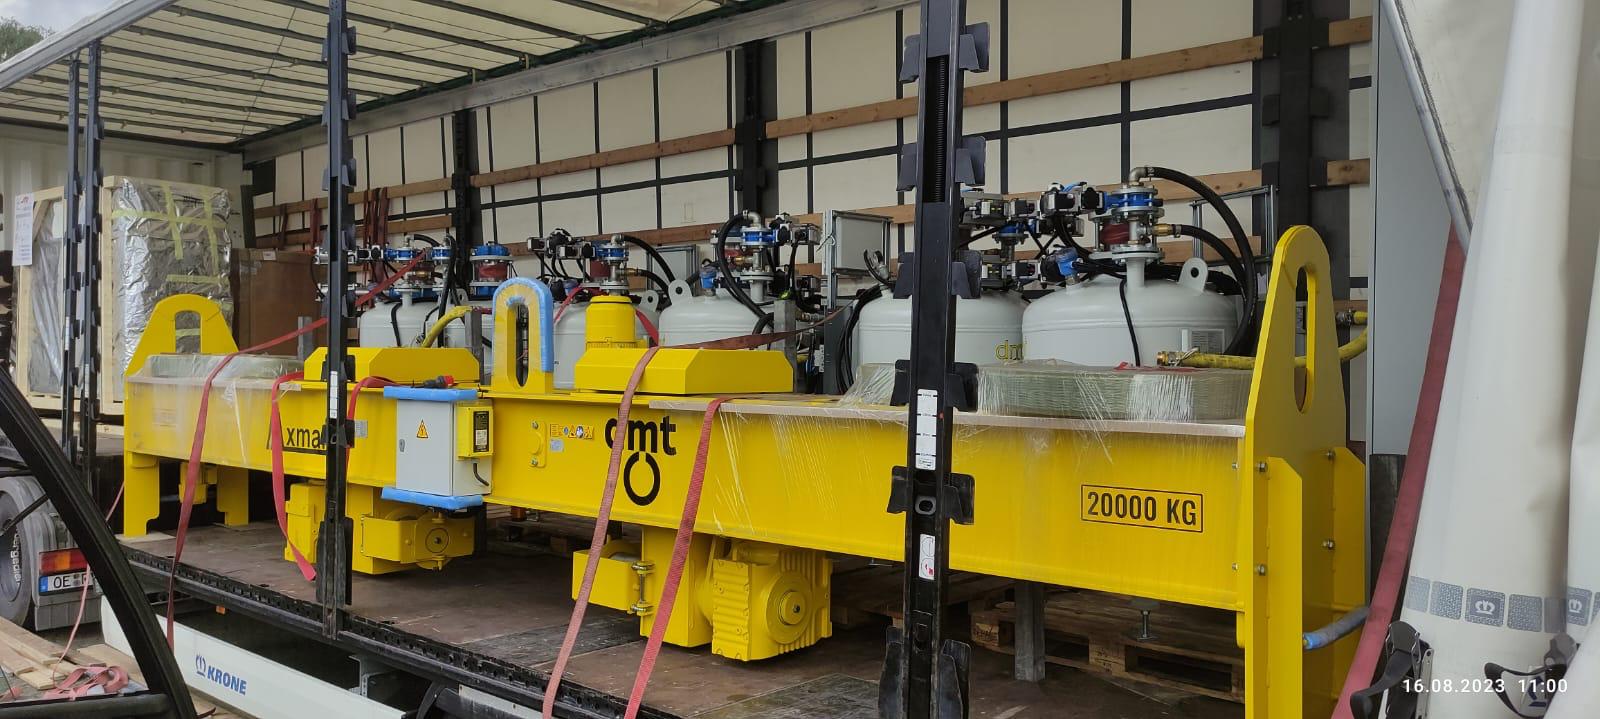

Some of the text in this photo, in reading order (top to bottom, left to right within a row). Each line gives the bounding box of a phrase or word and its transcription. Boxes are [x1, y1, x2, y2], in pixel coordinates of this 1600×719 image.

[1087, 491, 1197, 526] 20000 KG
[53, 575, 71, 589] OE
[207, 665, 247, 695] KRONE
